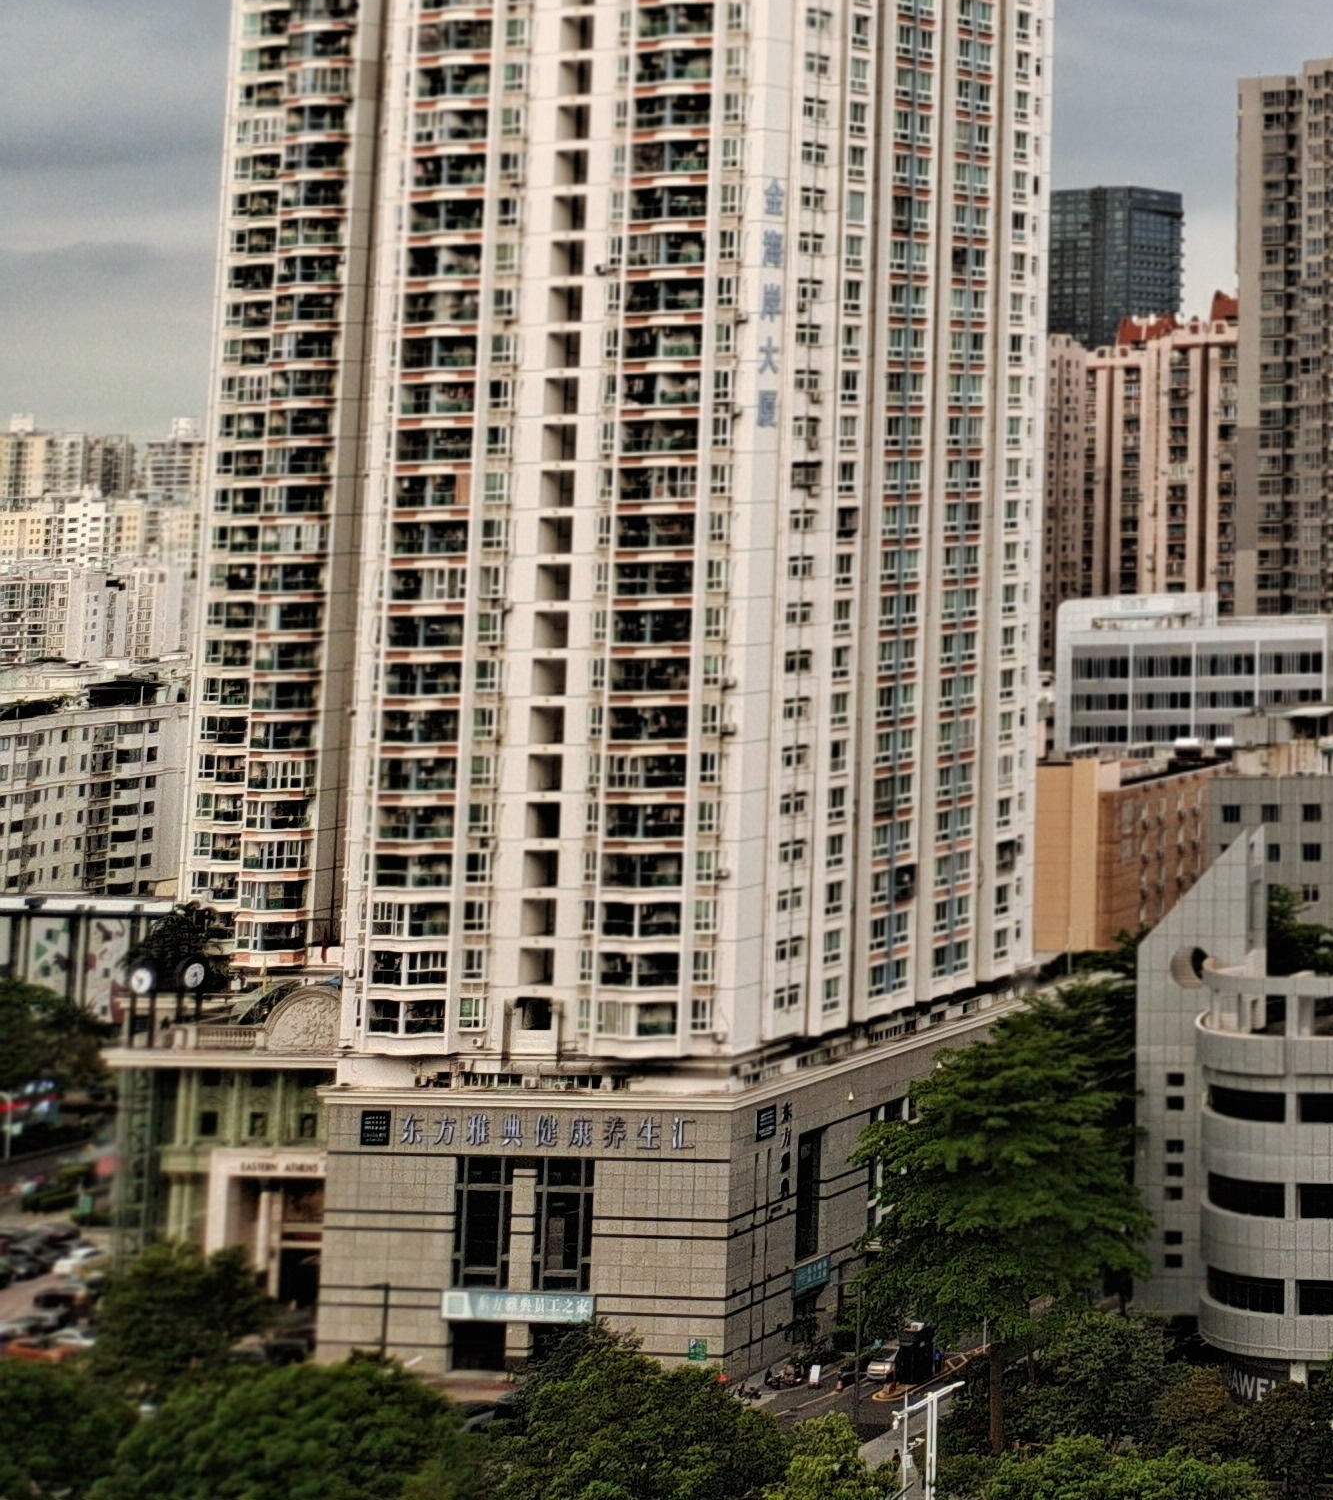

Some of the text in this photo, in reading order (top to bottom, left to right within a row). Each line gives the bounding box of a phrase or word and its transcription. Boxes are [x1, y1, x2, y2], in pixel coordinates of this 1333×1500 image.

[400, 1113, 696, 1150] 东方雅典健康养生汇
[241, 1162, 277, 1172] EASTERN
